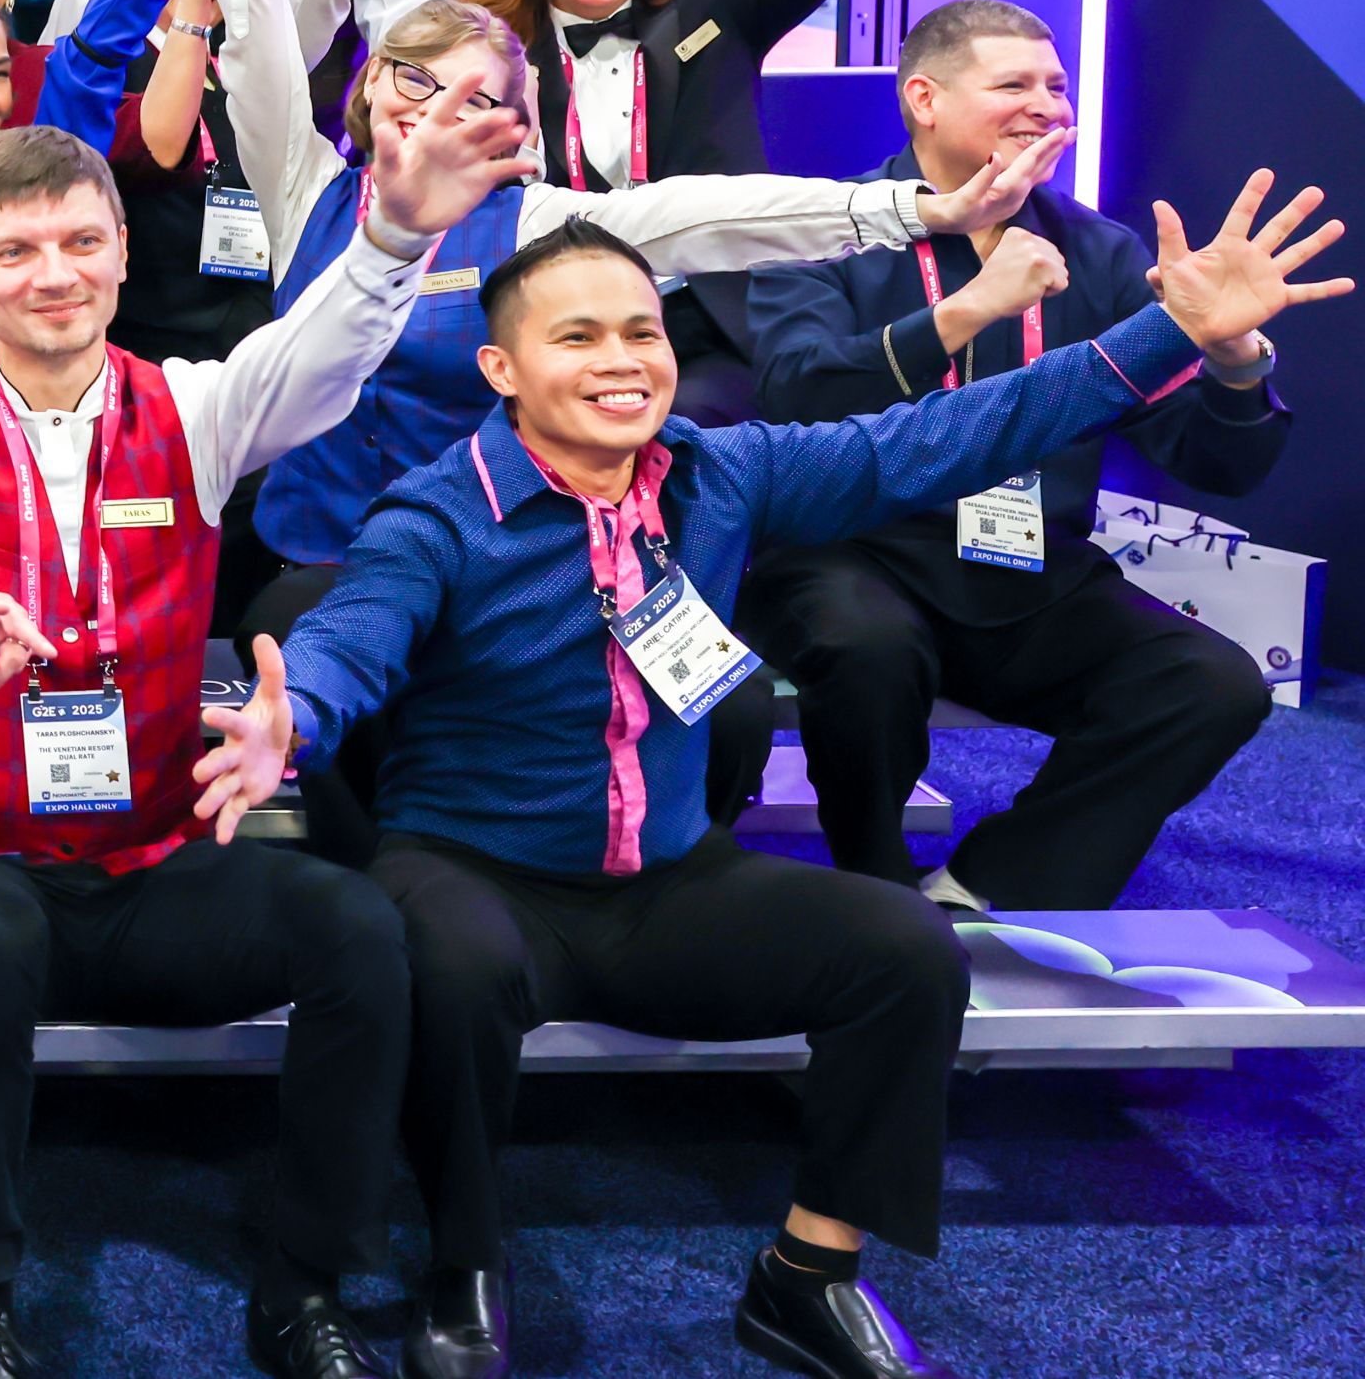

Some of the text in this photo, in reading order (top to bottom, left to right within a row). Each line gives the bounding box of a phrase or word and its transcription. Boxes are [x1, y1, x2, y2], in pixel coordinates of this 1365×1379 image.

[19, 464, 34, 521] Ortak.me
[123, 509, 151, 518] TARAS
[972, 551, 1031, 567] EXPO HALL ONLY
[622, 589, 677, 637] G2E 2025
[641, 605, 692, 651] ARIEL CATIPAY
[672, 637, 693, 657] DEALER
[693, 694, 713, 713] EXPO
[711, 679, 730, 696] HALL
[728, 664, 747, 681] ONLY
[32, 704, 102, 717] G2E 2025
[46, 804, 69, 812] EXPO
[72, 803, 93, 811] HALL
